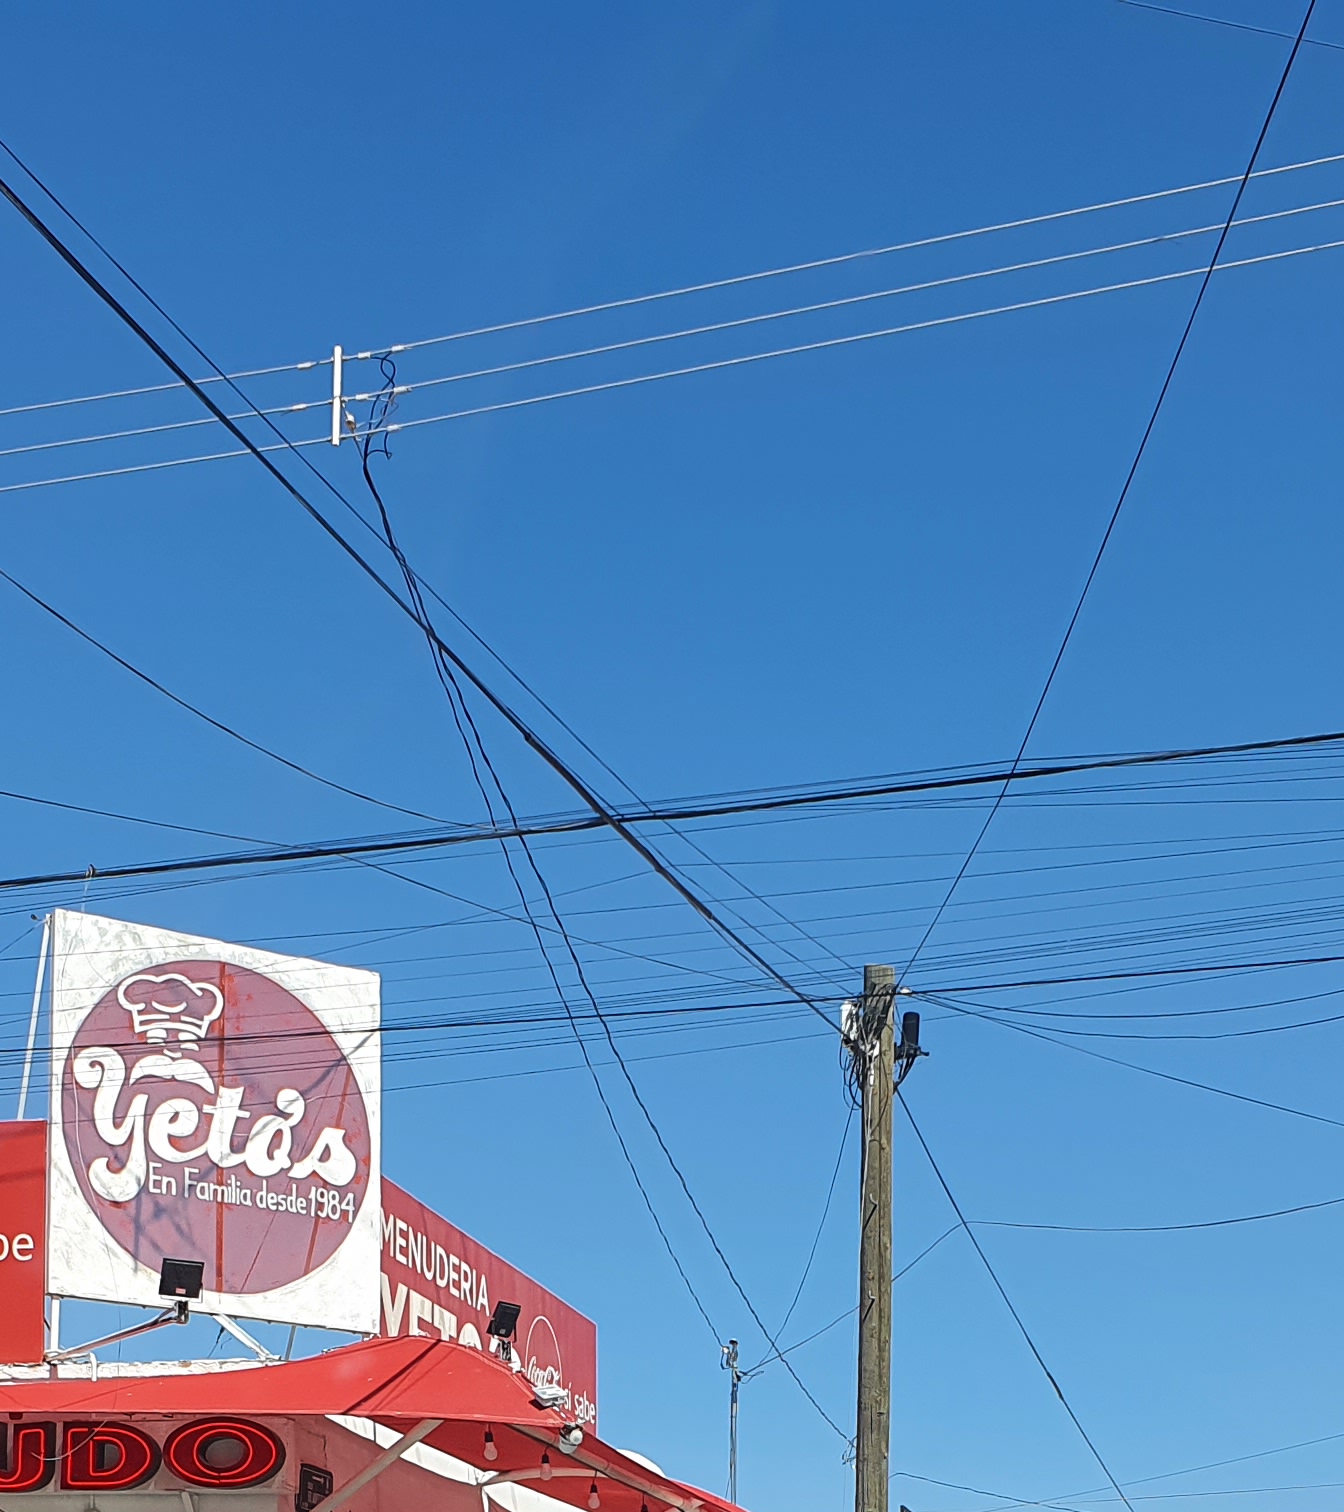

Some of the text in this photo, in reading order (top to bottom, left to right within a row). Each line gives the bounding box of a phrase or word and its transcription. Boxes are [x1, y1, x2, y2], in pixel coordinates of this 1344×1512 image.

[148, 1162, 355, 1223] En Familia desde 1984
[380, 1206, 491, 1317] MENUDERIA
[574, 1390, 596, 1424] sabe
